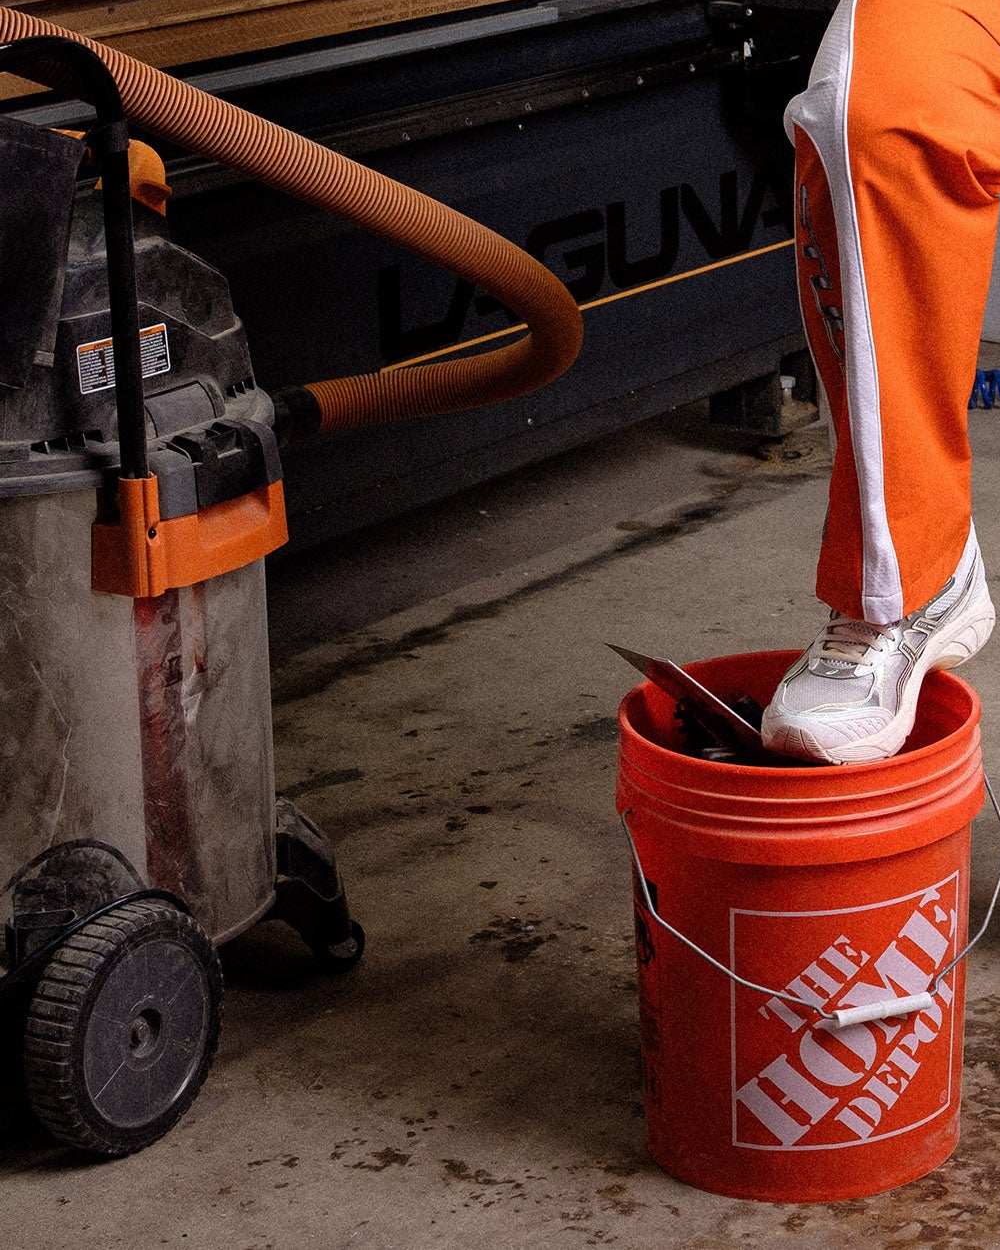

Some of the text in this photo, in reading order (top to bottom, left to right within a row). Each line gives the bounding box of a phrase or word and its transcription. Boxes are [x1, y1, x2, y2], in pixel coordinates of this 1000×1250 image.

[736, 887, 957, 1147] HOME
[758, 934, 871, 1033] THE
[835, 967, 953, 1141] DEPOT
